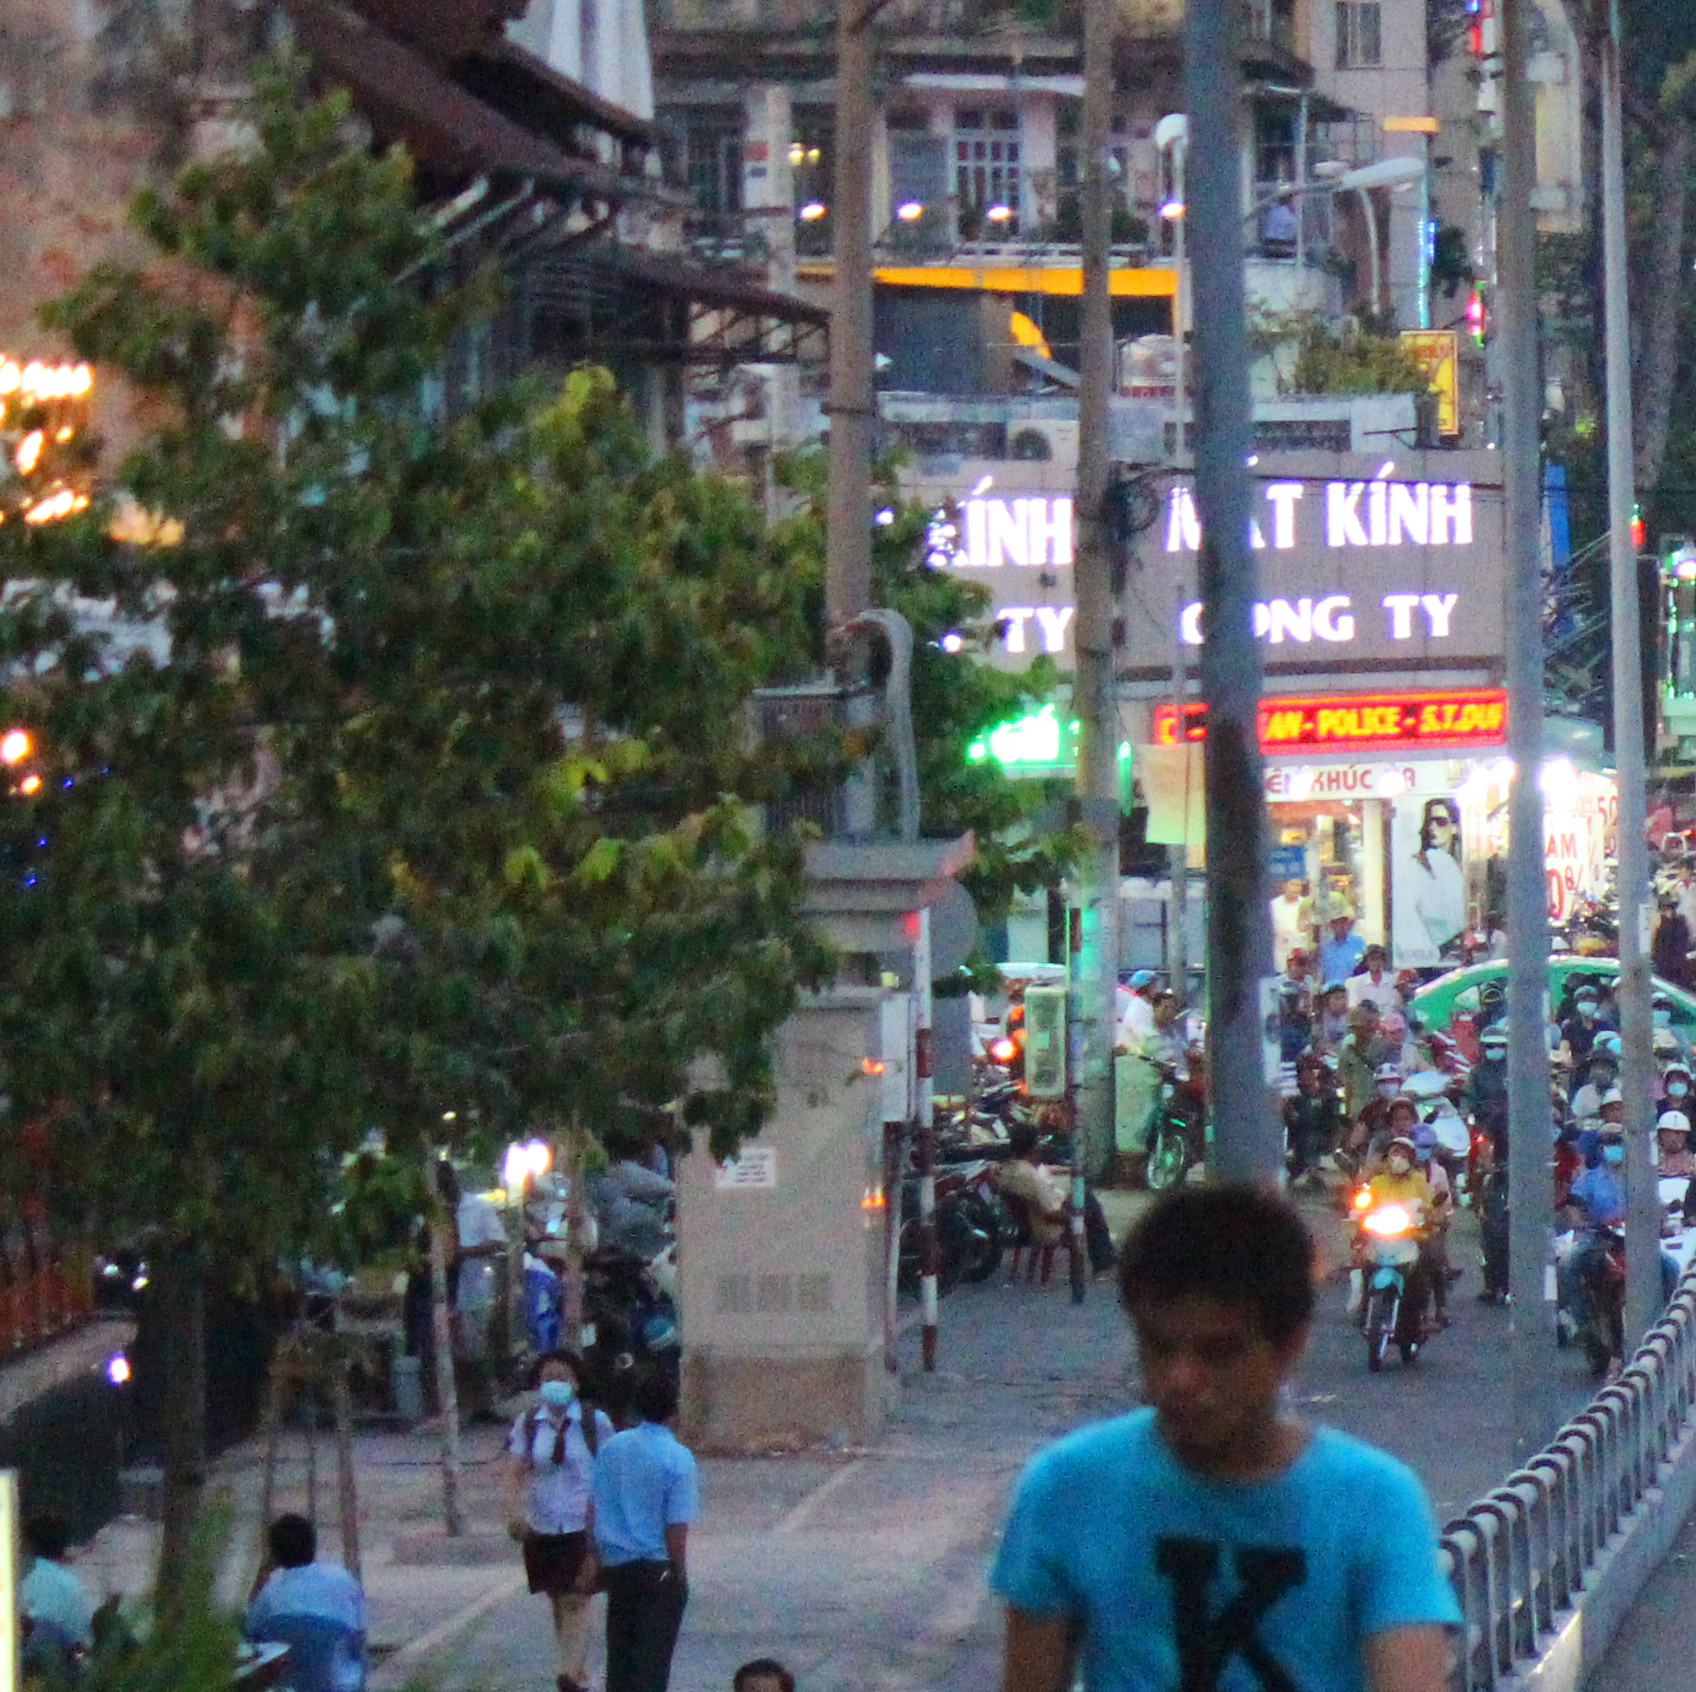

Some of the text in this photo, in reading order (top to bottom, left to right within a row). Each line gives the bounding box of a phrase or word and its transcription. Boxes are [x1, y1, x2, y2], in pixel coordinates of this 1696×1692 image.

[1325, 461, 1473, 547] KÍNH
[997, 607, 1073, 653] TY
[1381, 593, 1459, 639] TY
[1317, 705, 1401, 737] POLICE
